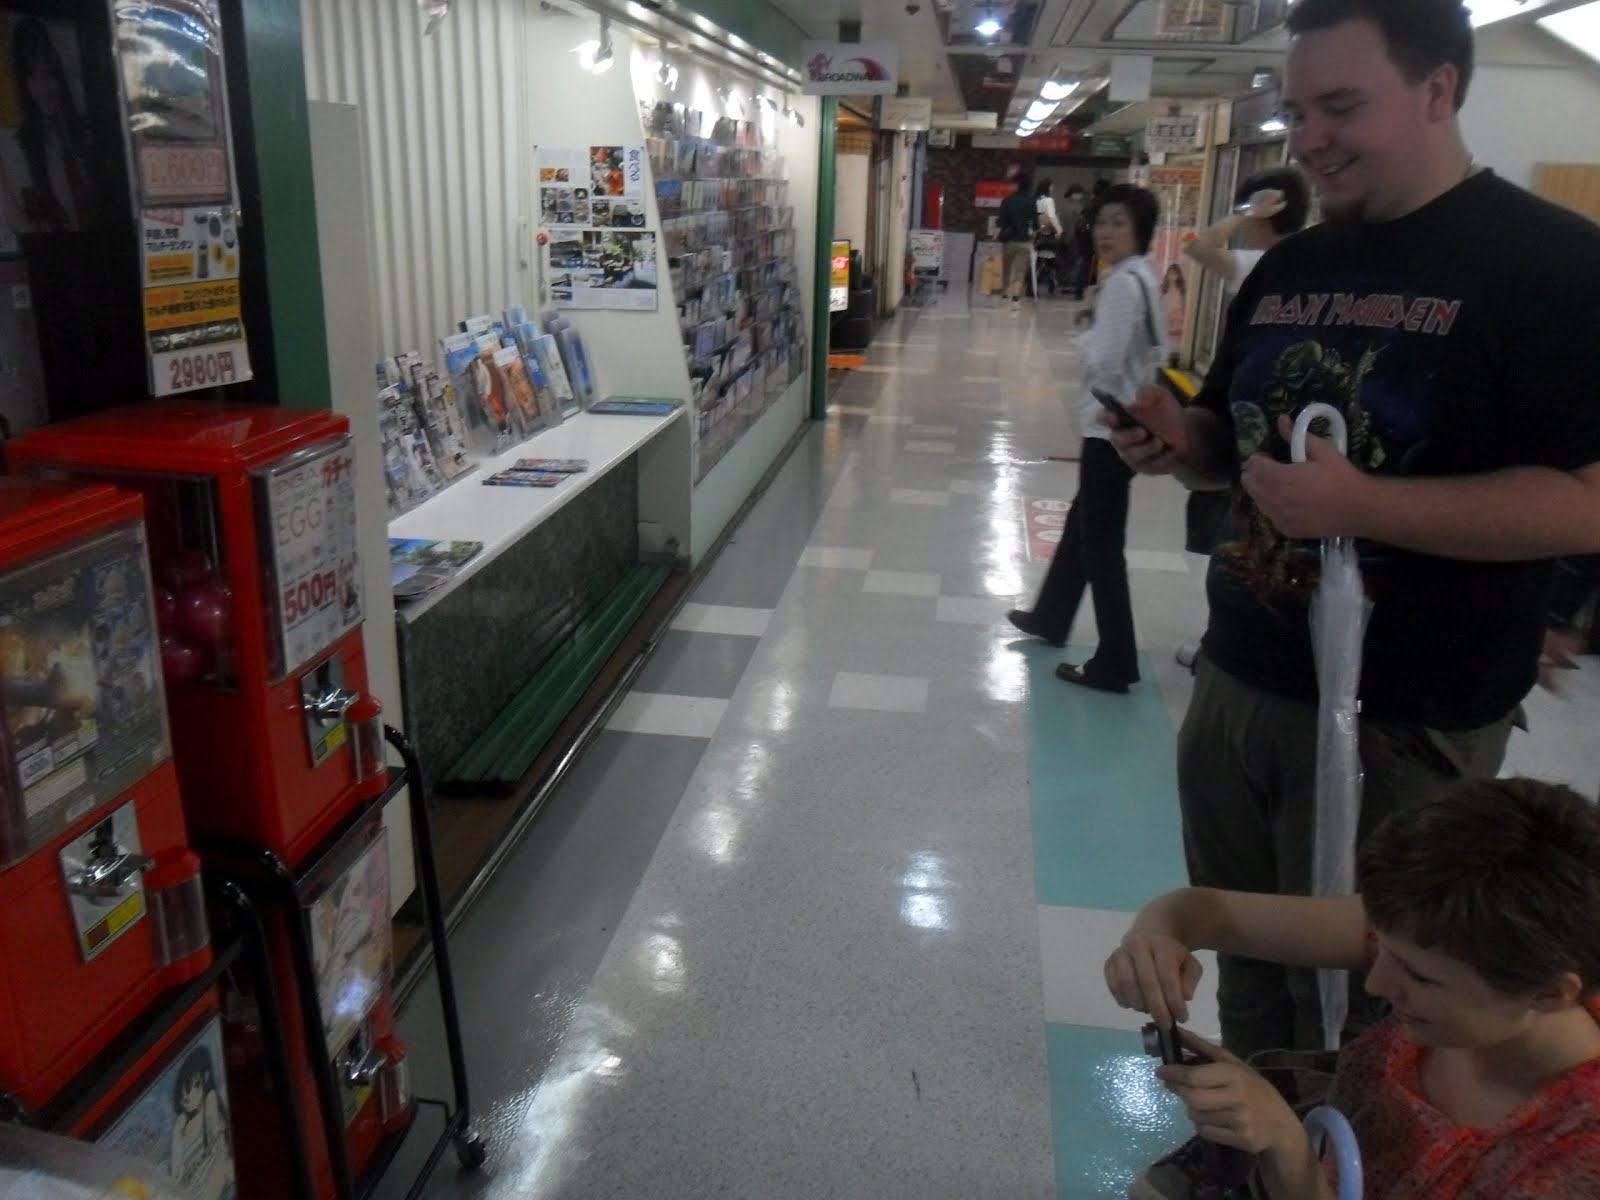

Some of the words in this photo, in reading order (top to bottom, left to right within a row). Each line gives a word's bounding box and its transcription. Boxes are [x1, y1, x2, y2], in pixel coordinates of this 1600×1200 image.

[629, 149, 641, 182] 食べる
[1249, 294, 1331, 326] IRON
[1323, 293, 1462, 336] MAIDEN
[169, 350, 236, 390] 2980円
[276, 497, 322, 545] EGG
[284, 568, 336, 626] 500円
